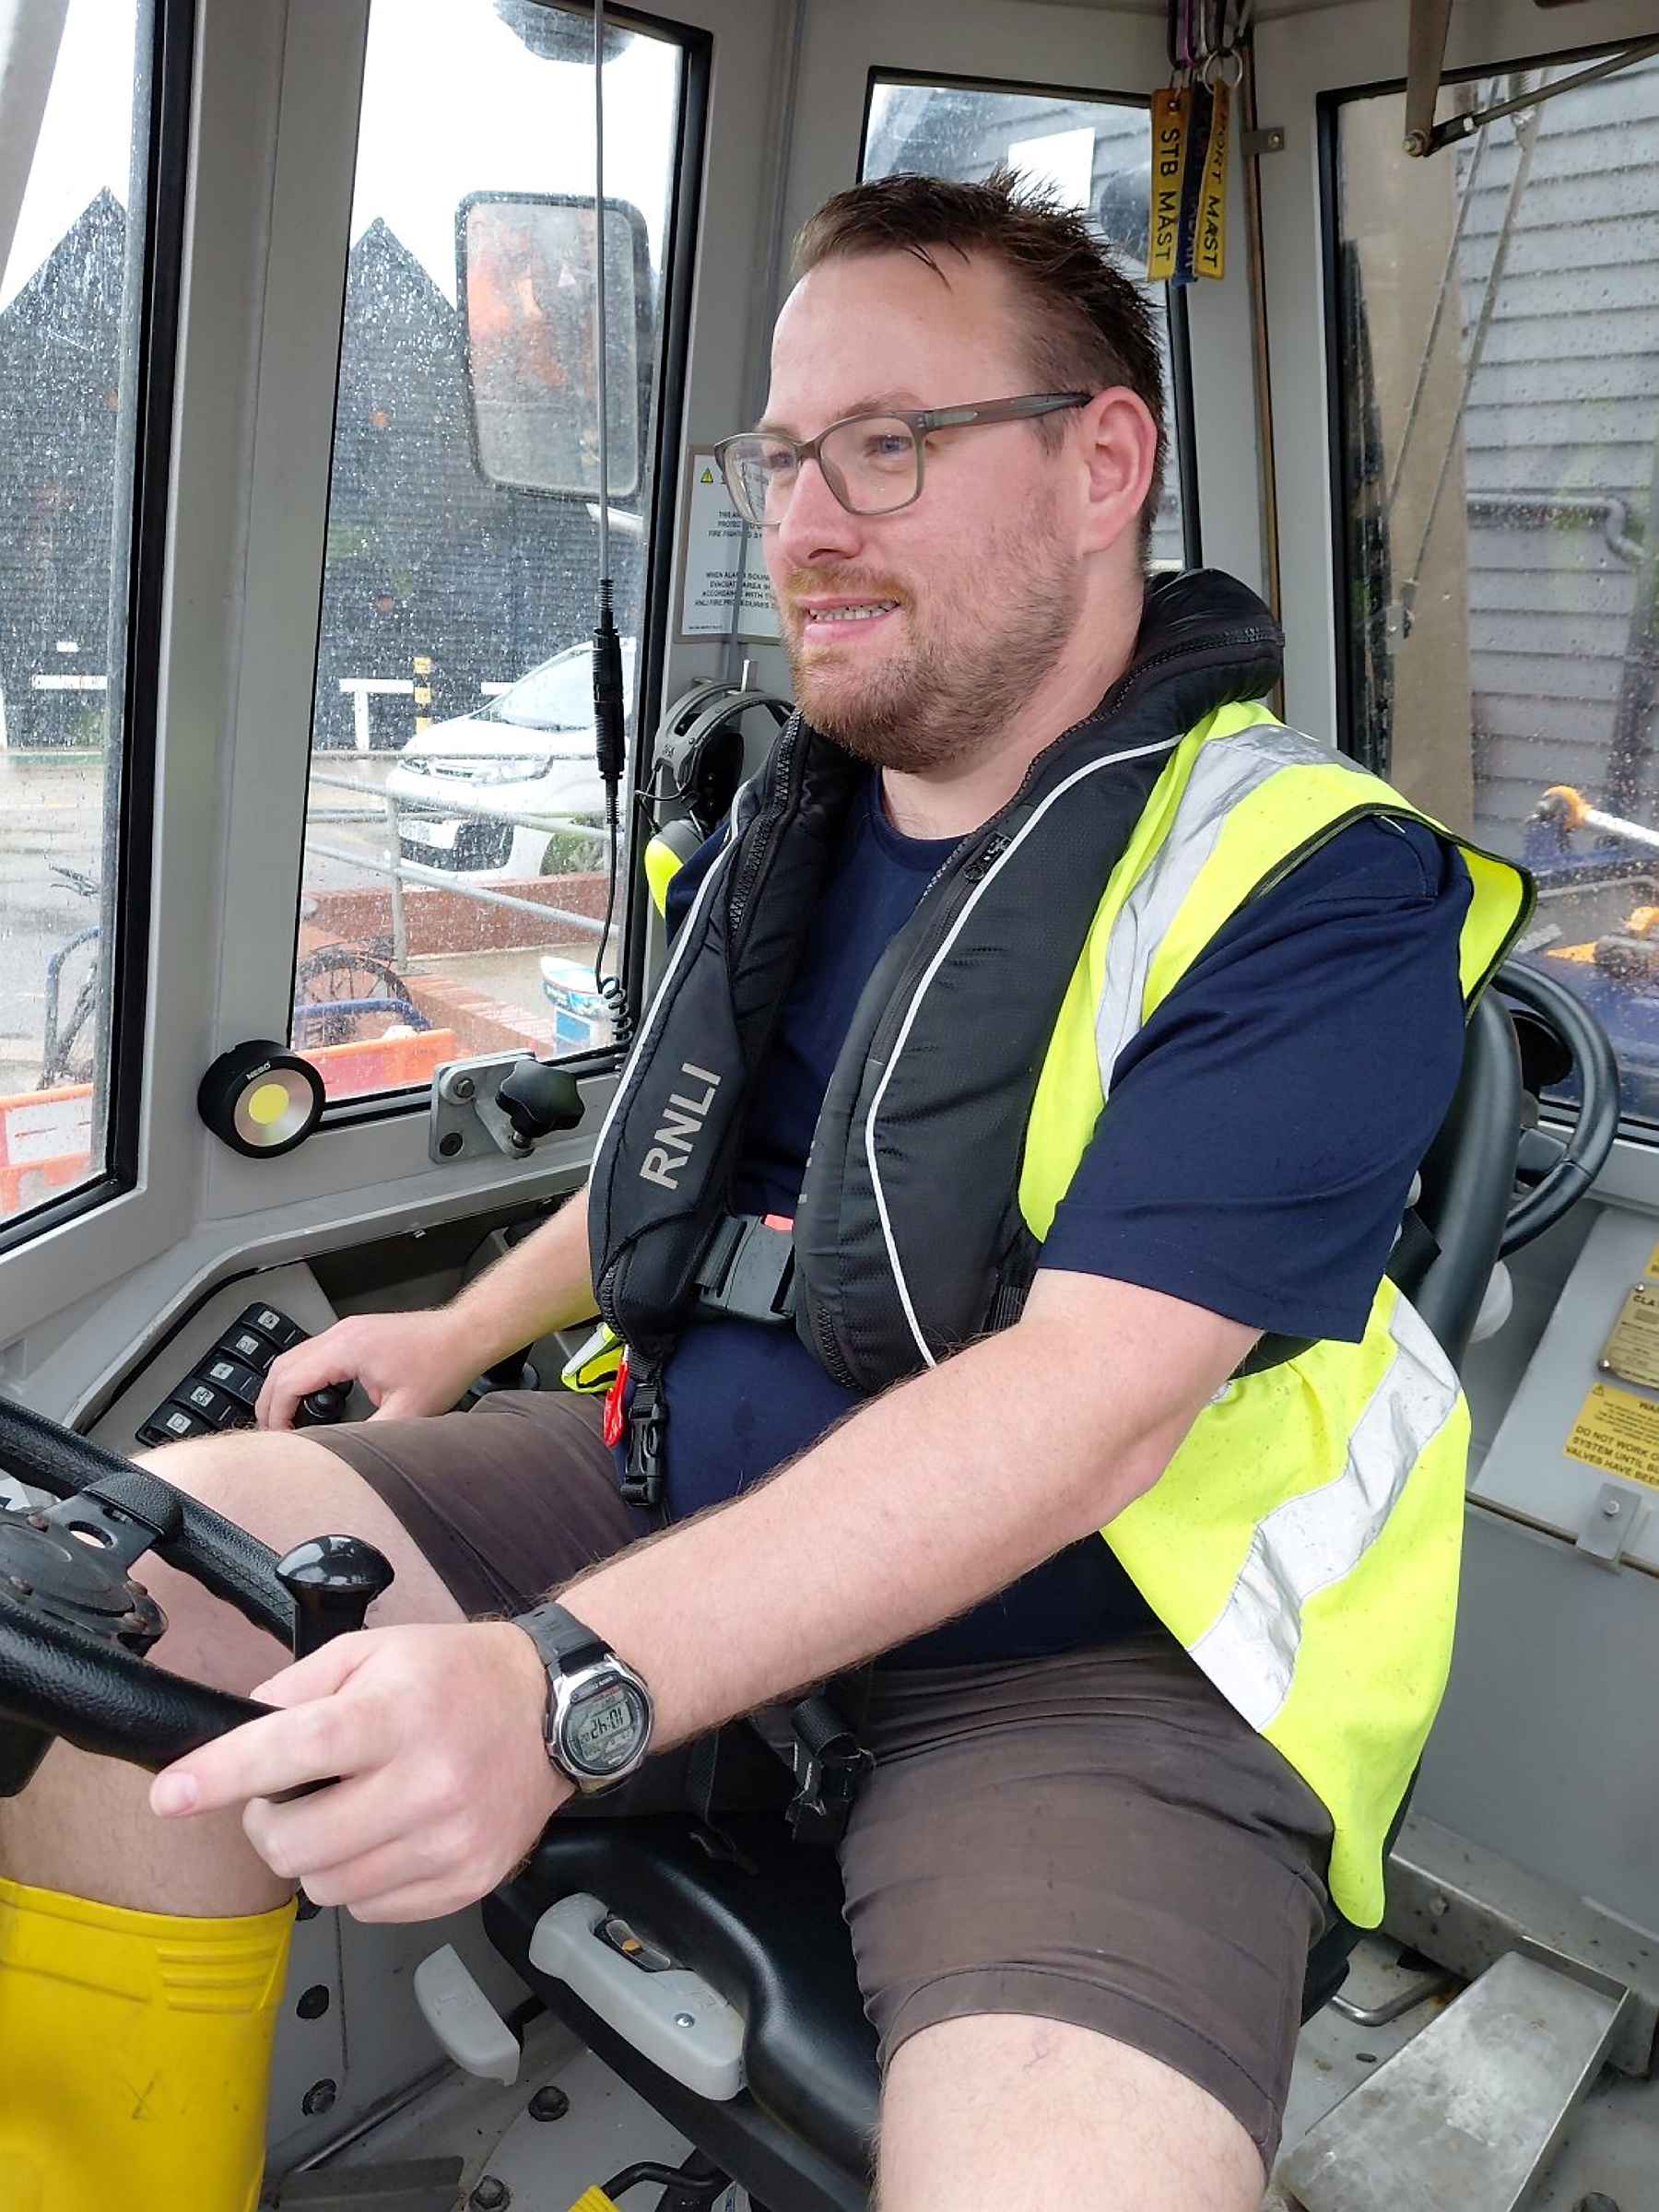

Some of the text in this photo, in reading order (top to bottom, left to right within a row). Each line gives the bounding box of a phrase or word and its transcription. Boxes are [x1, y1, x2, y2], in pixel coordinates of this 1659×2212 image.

[1156, 128, 1181, 262] STB MAST
[1202, 195, 1220, 268] MAST
[640, 1063, 722, 1190] RNLI
[1572, 1436, 1613, 1455] SYSTEM
[1614, 1451, 1643, 1468] UNTIL
[1575, 1426, 1591, 1436] DO
[1593, 1431, 1614, 1444] NOT
[1617, 1440, 1648, 1457] WORK
[1566, 1446, 1603, 1465] VALVES
[1604, 1460, 1631, 1476] HAVE
[592, 1707, 623, 1739] 10:42
